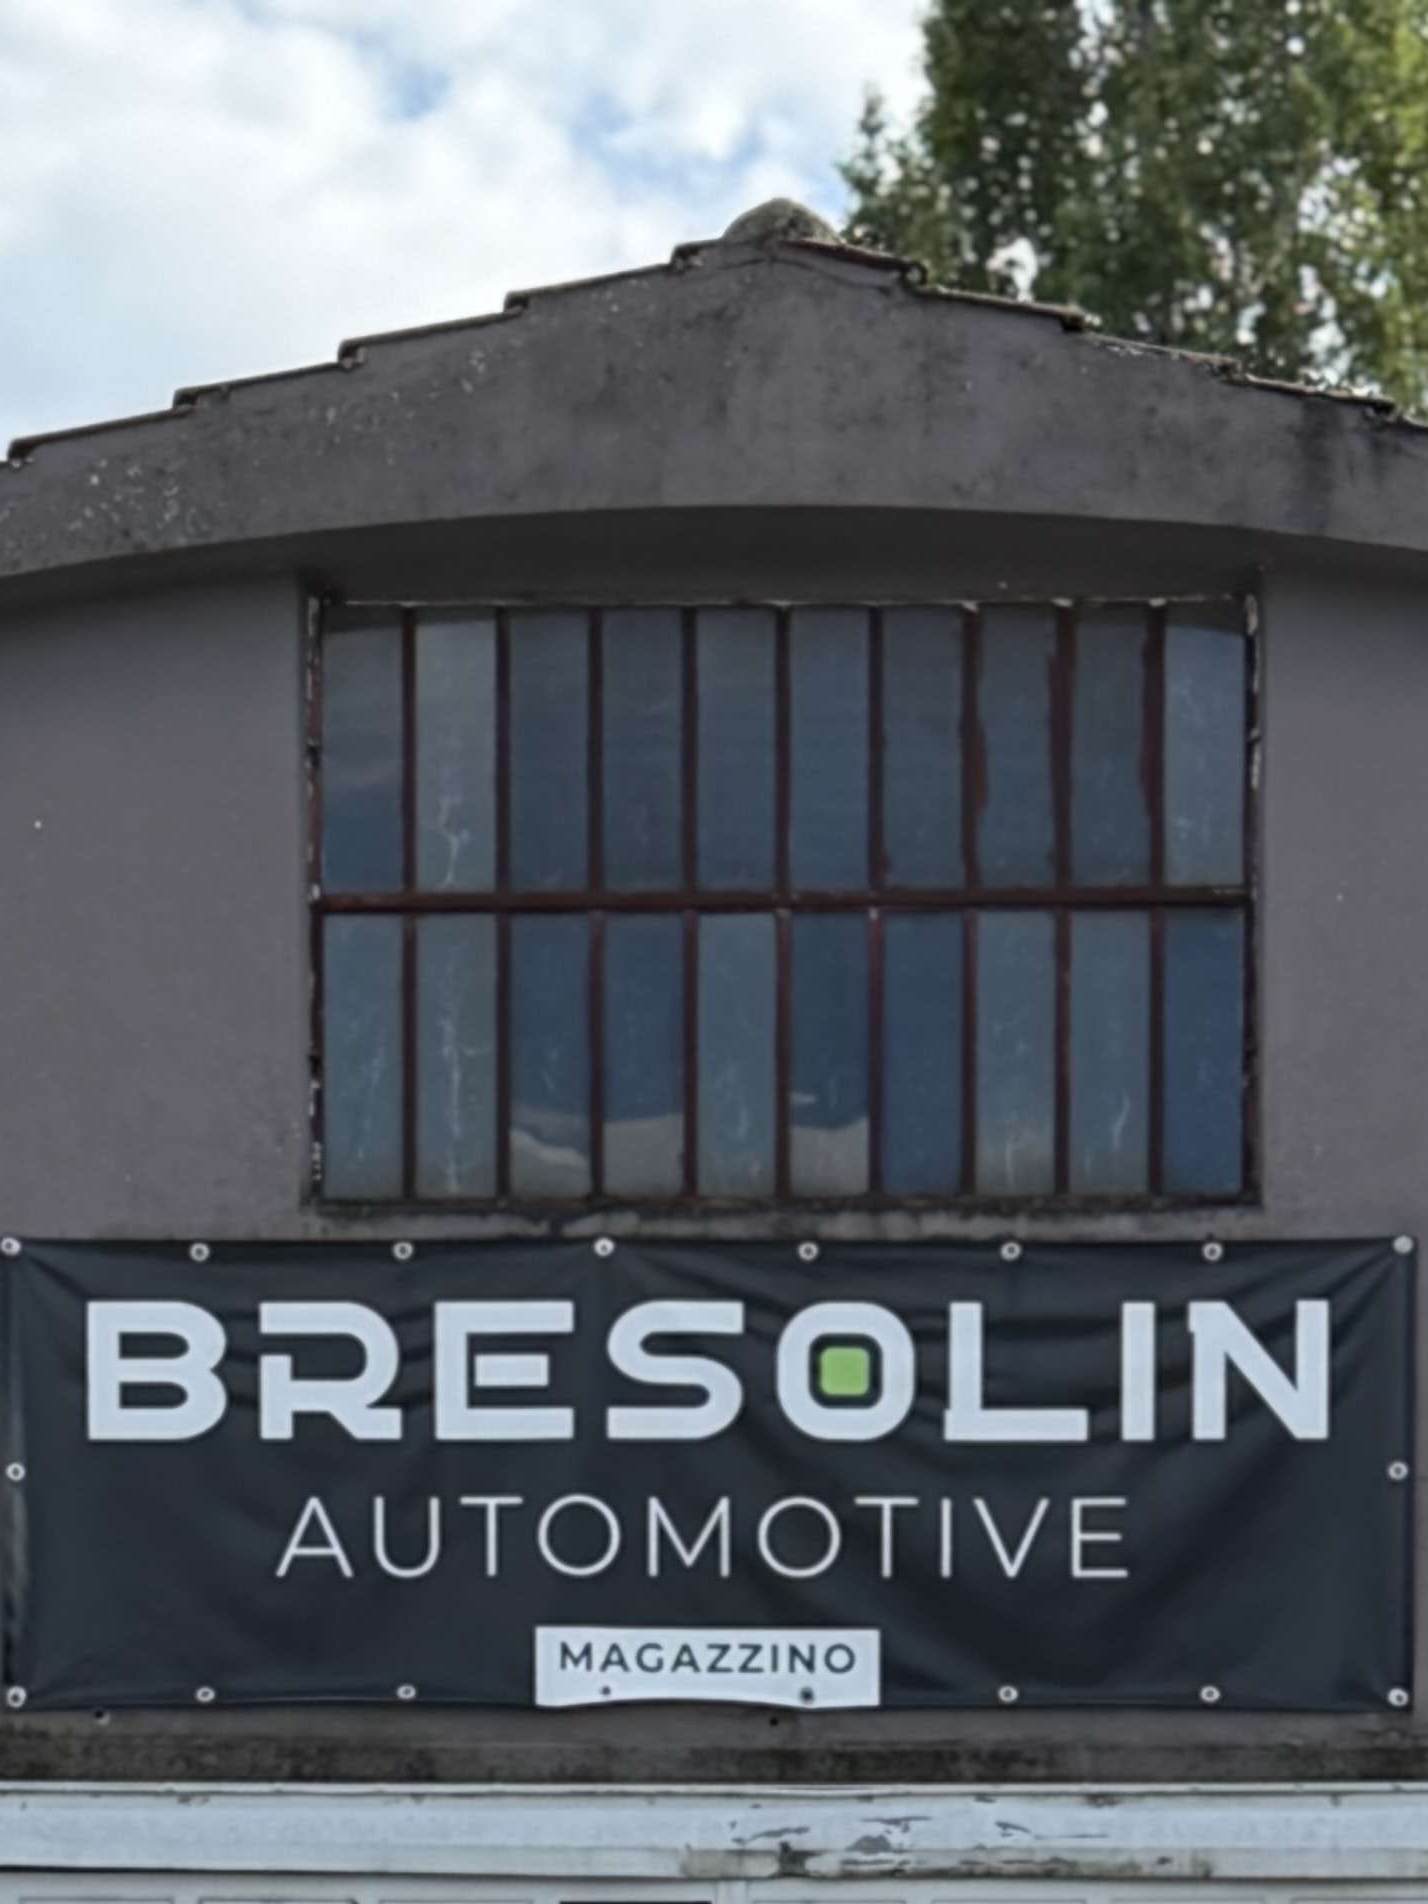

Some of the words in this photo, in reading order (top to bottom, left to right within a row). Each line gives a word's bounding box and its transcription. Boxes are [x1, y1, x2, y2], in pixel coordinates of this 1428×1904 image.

[87, 1300, 1331, 1443] BRESOLIN
[276, 1494, 1130, 1580] AUTOMOTIVE
[559, 1641, 857, 1676] MAGAZZINO
